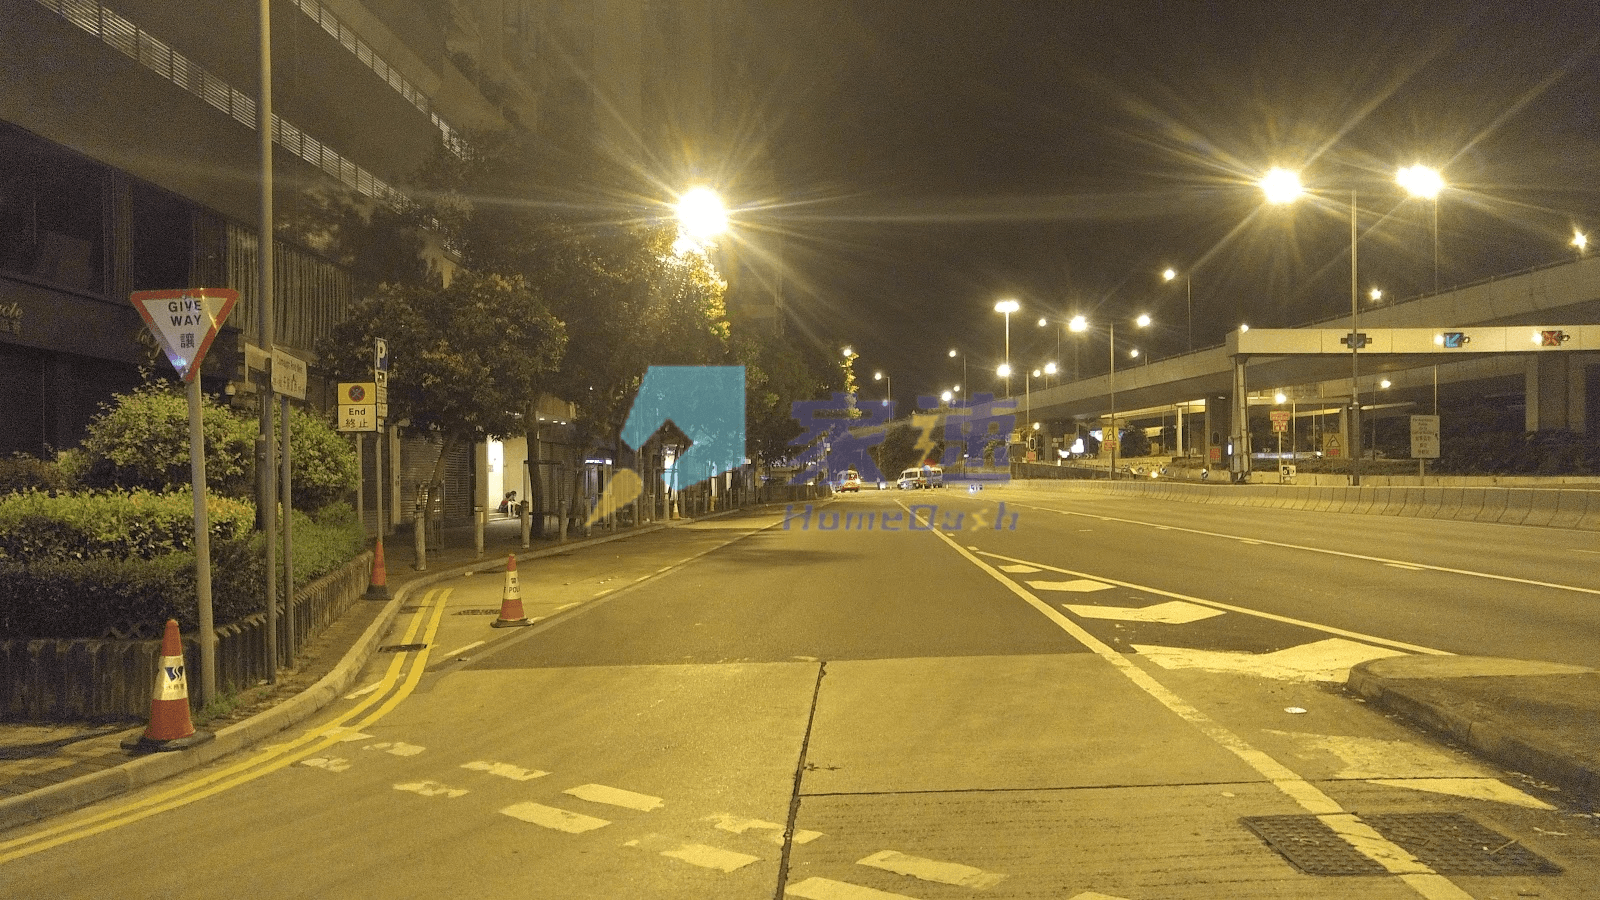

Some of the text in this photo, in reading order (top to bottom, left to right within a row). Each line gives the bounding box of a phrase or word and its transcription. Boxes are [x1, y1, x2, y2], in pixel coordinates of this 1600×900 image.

[168, 300, 202, 312] GIVE
[170, 314, 202, 327] WAY
[180, 333, 195, 349] 讓
[377, 340, 386, 368] P
[342, 418, 369, 429] 終止
